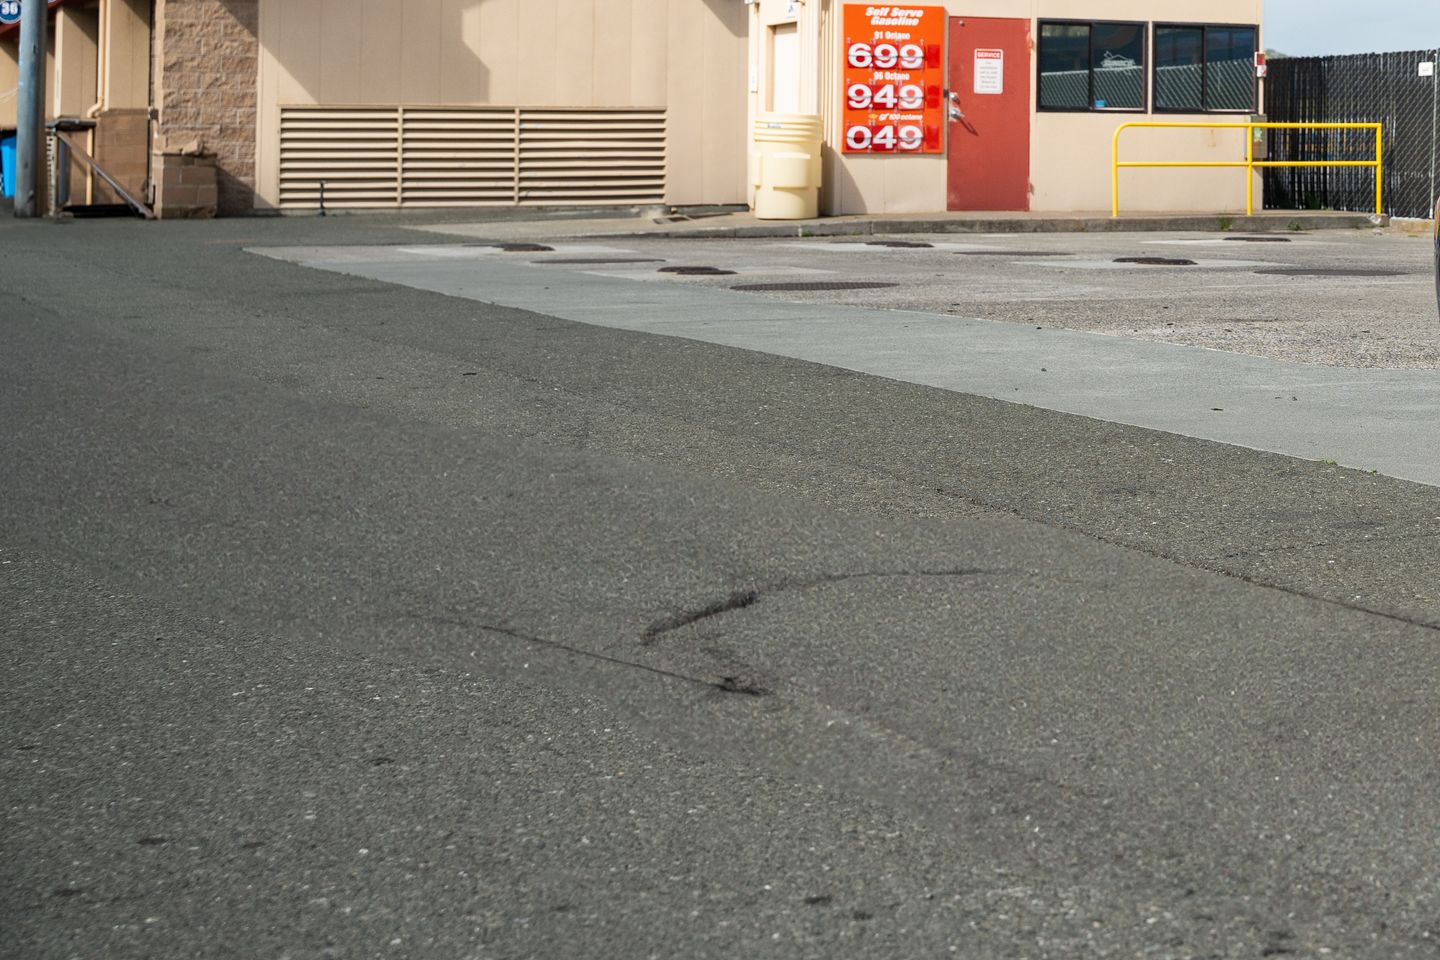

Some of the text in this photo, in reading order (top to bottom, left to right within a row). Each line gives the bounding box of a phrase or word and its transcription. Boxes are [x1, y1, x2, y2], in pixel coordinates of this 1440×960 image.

[865, 7, 924, 18] Self Serve
[871, 16, 919, 26] Gasoline
[885, 31, 910, 40] Octane
[848, 43, 924, 68] 6.99
[847, 83, 923, 109] 9.49
